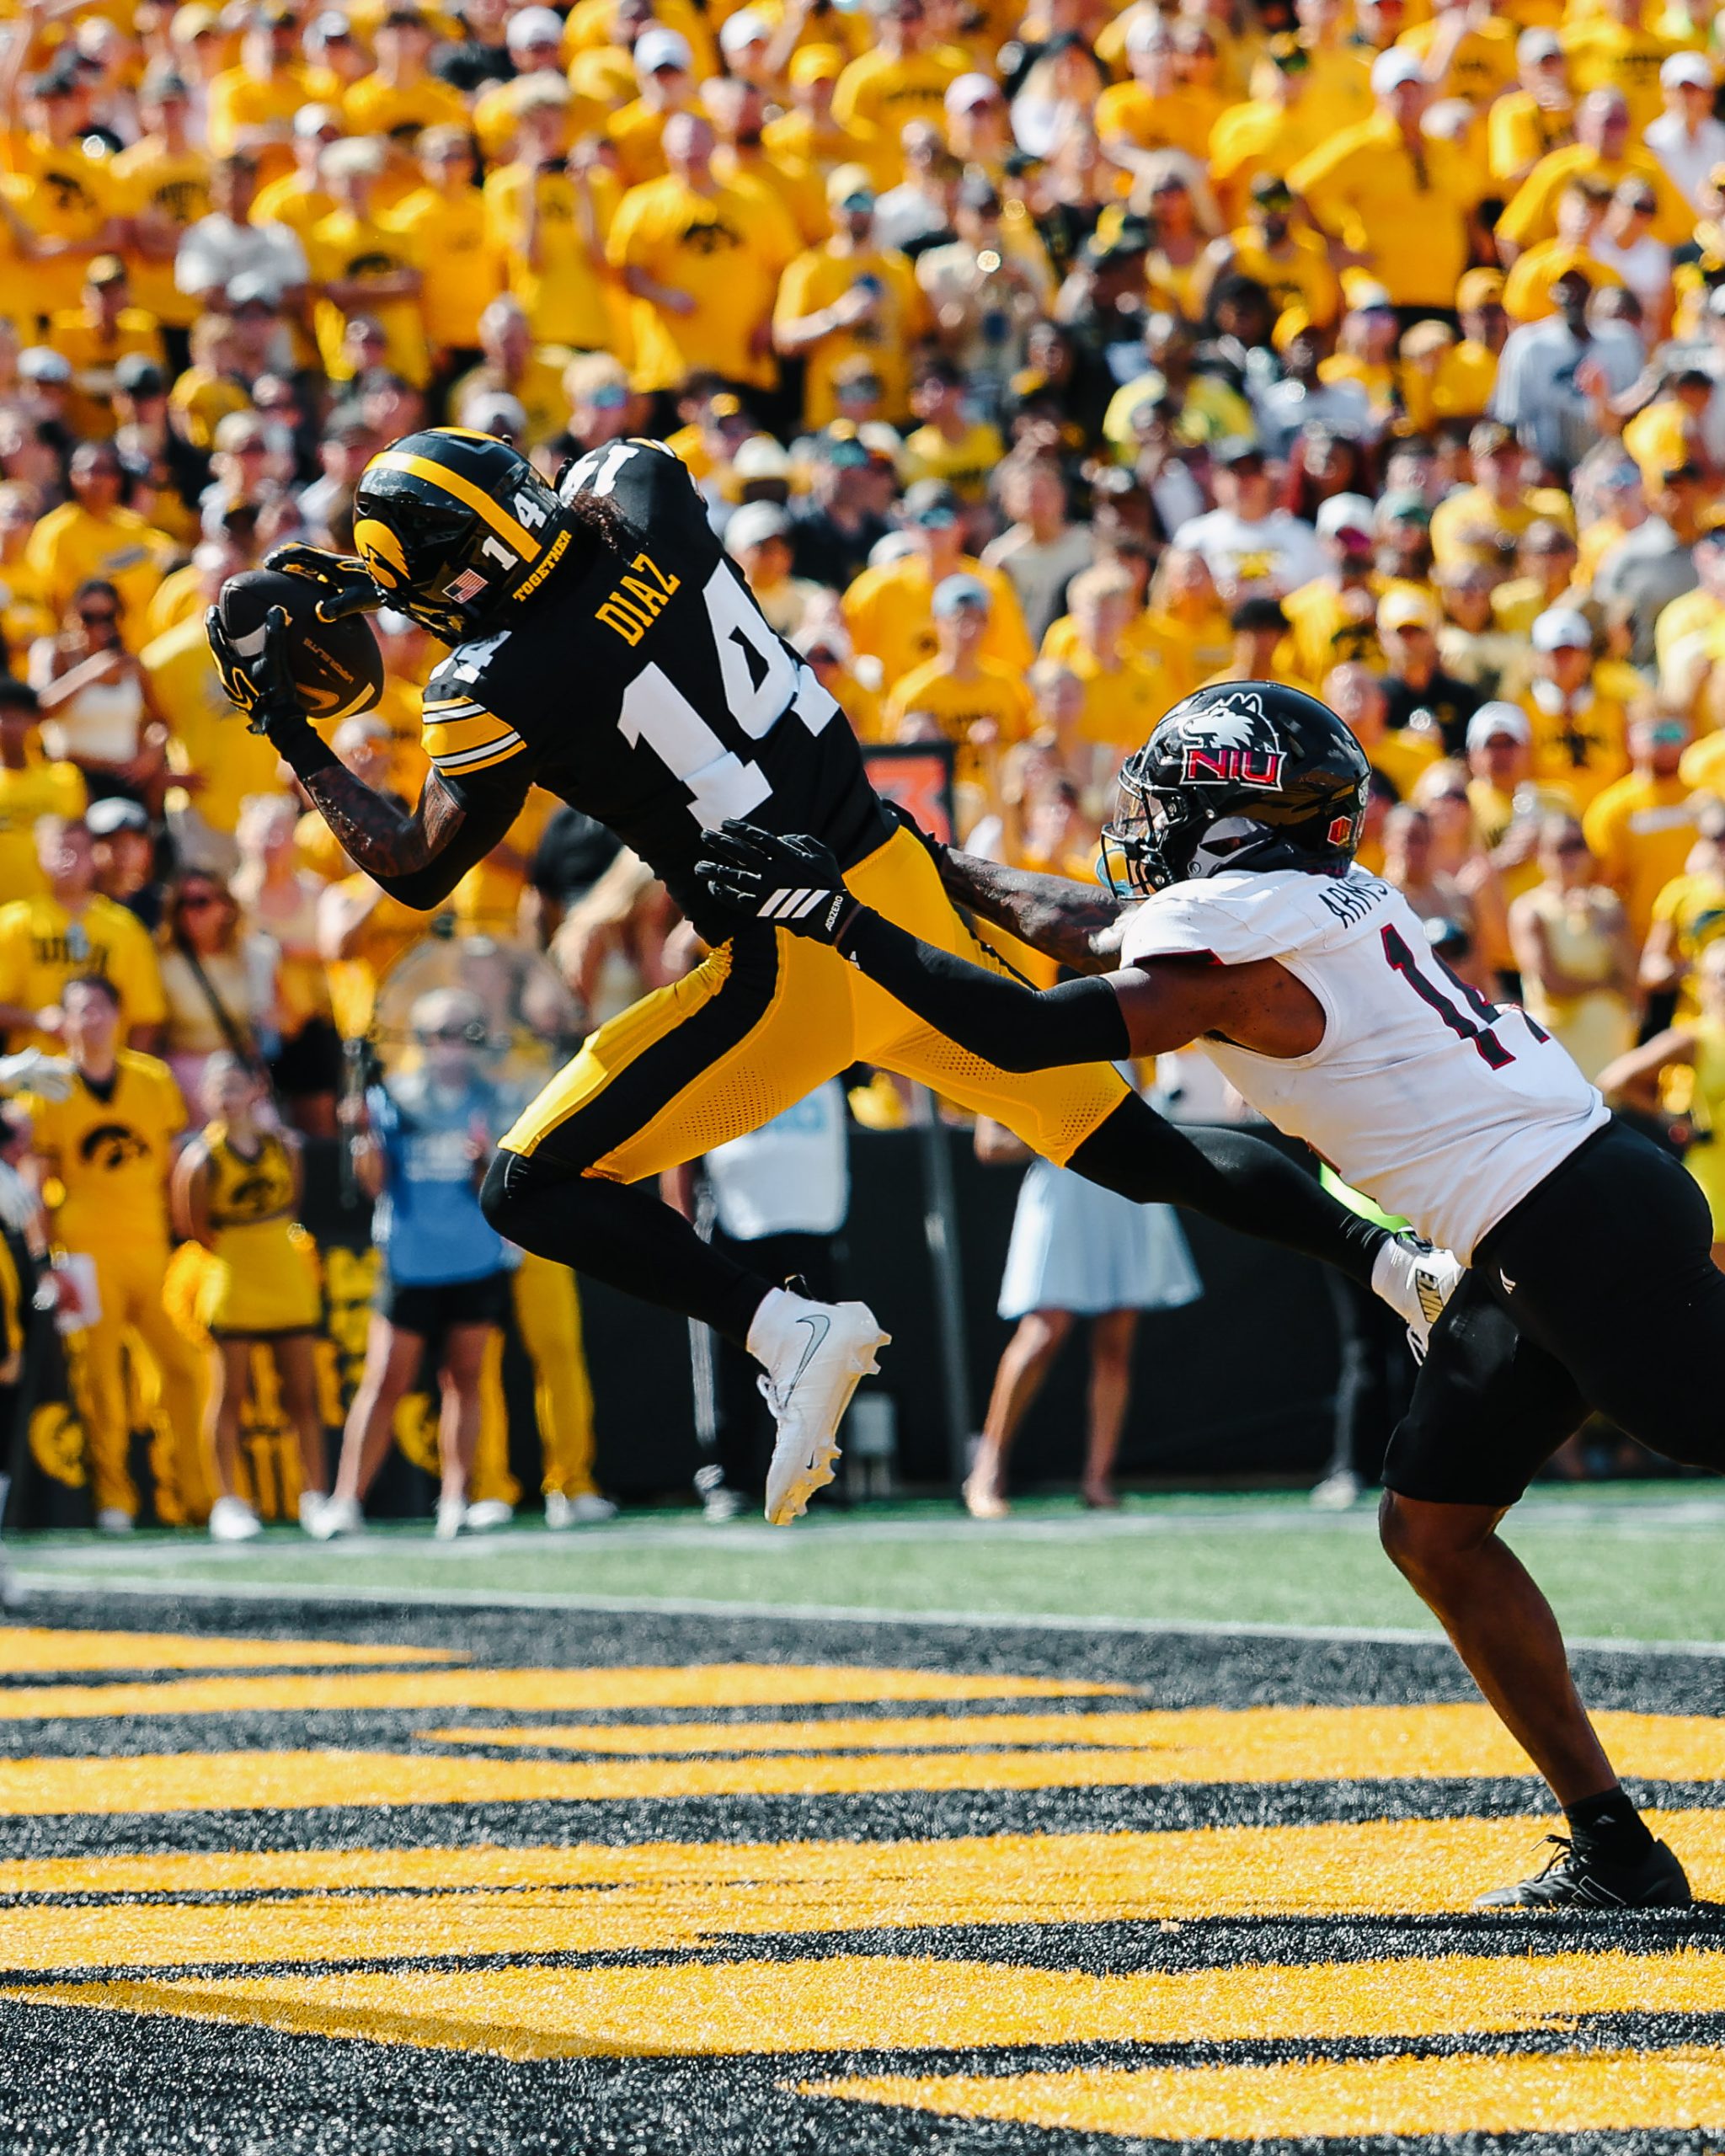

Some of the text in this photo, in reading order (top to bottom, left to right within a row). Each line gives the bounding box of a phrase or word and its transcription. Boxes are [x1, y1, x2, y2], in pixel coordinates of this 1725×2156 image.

[512, 529, 573, 602] TOGETHER
[595, 552, 681, 647] DIAZ
[617, 558, 841, 831] 14
[1188, 749, 1278, 784] NIU
[825, 894, 844, 932] ADIZERO
[1416, 1268, 1445, 1324] NIKE
